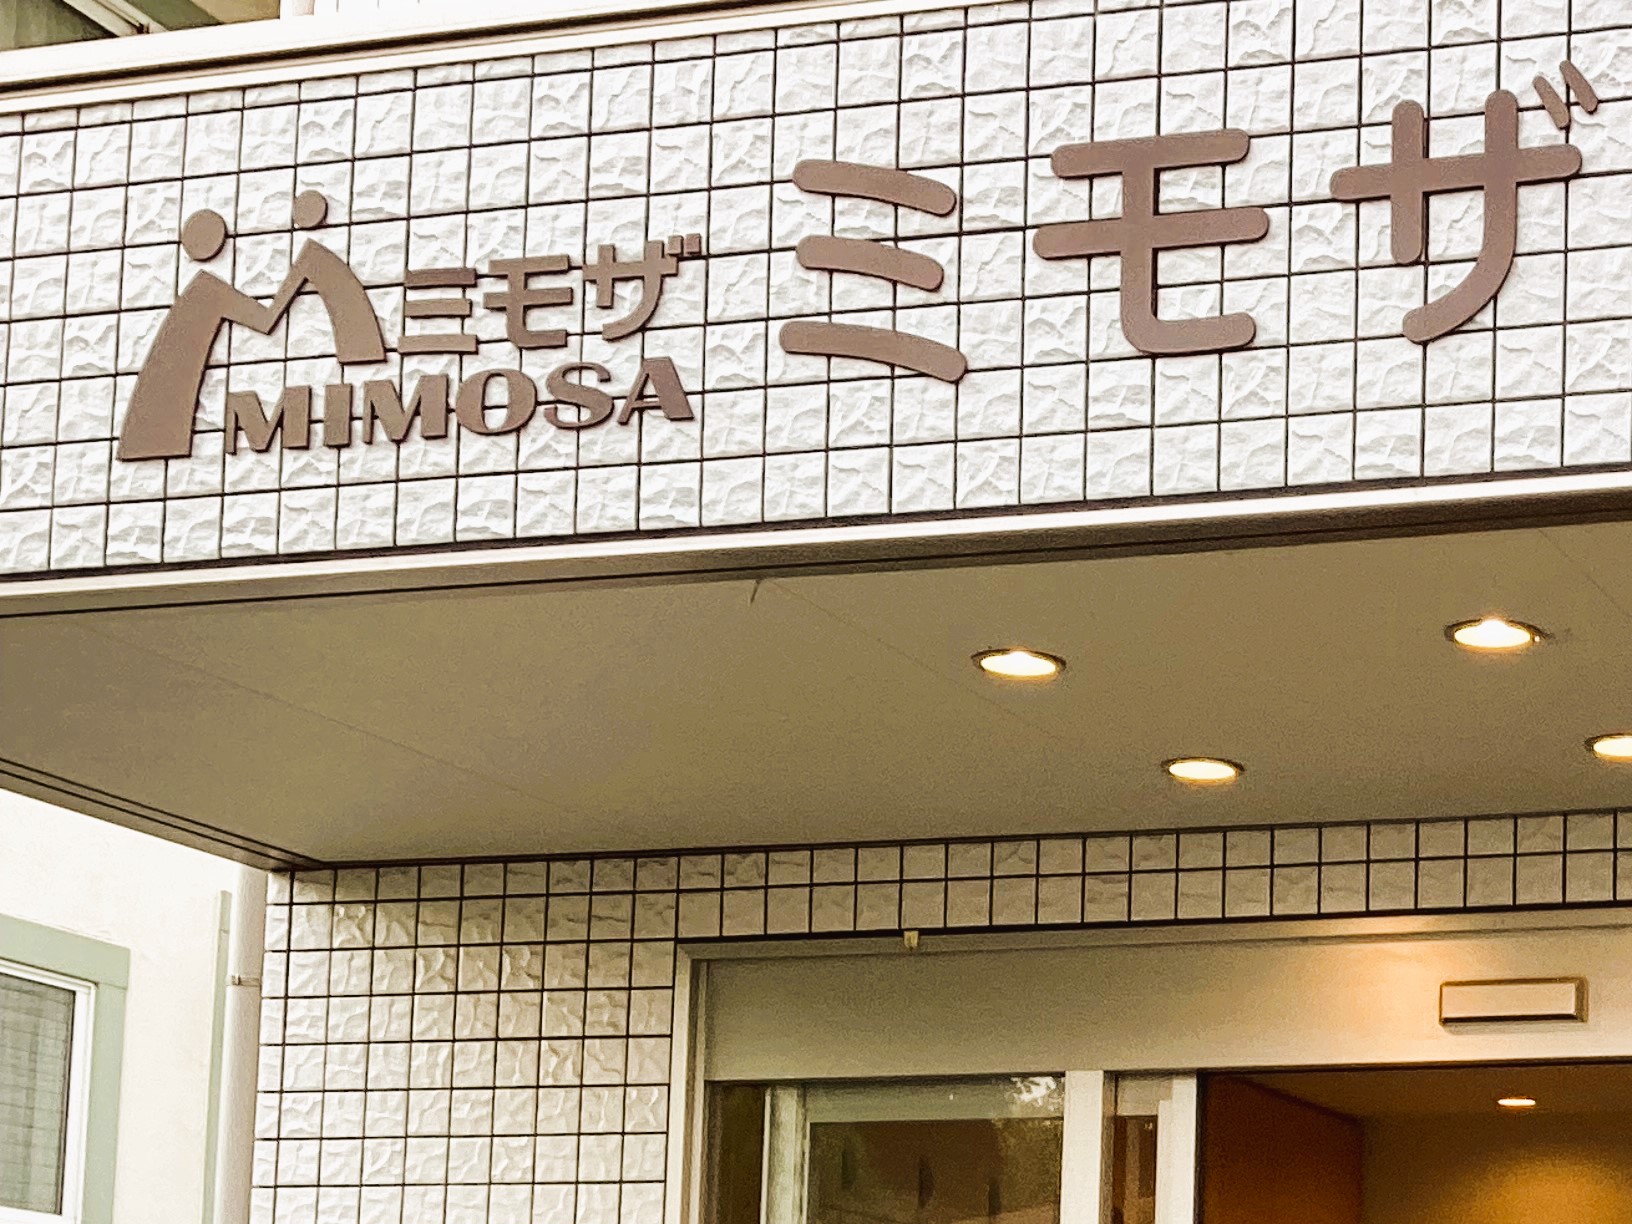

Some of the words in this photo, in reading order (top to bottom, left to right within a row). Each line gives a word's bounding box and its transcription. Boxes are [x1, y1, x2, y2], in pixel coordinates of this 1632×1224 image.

[402, 232, 702, 355] ミモザ
[224, 356, 695, 456] MIMOSA
